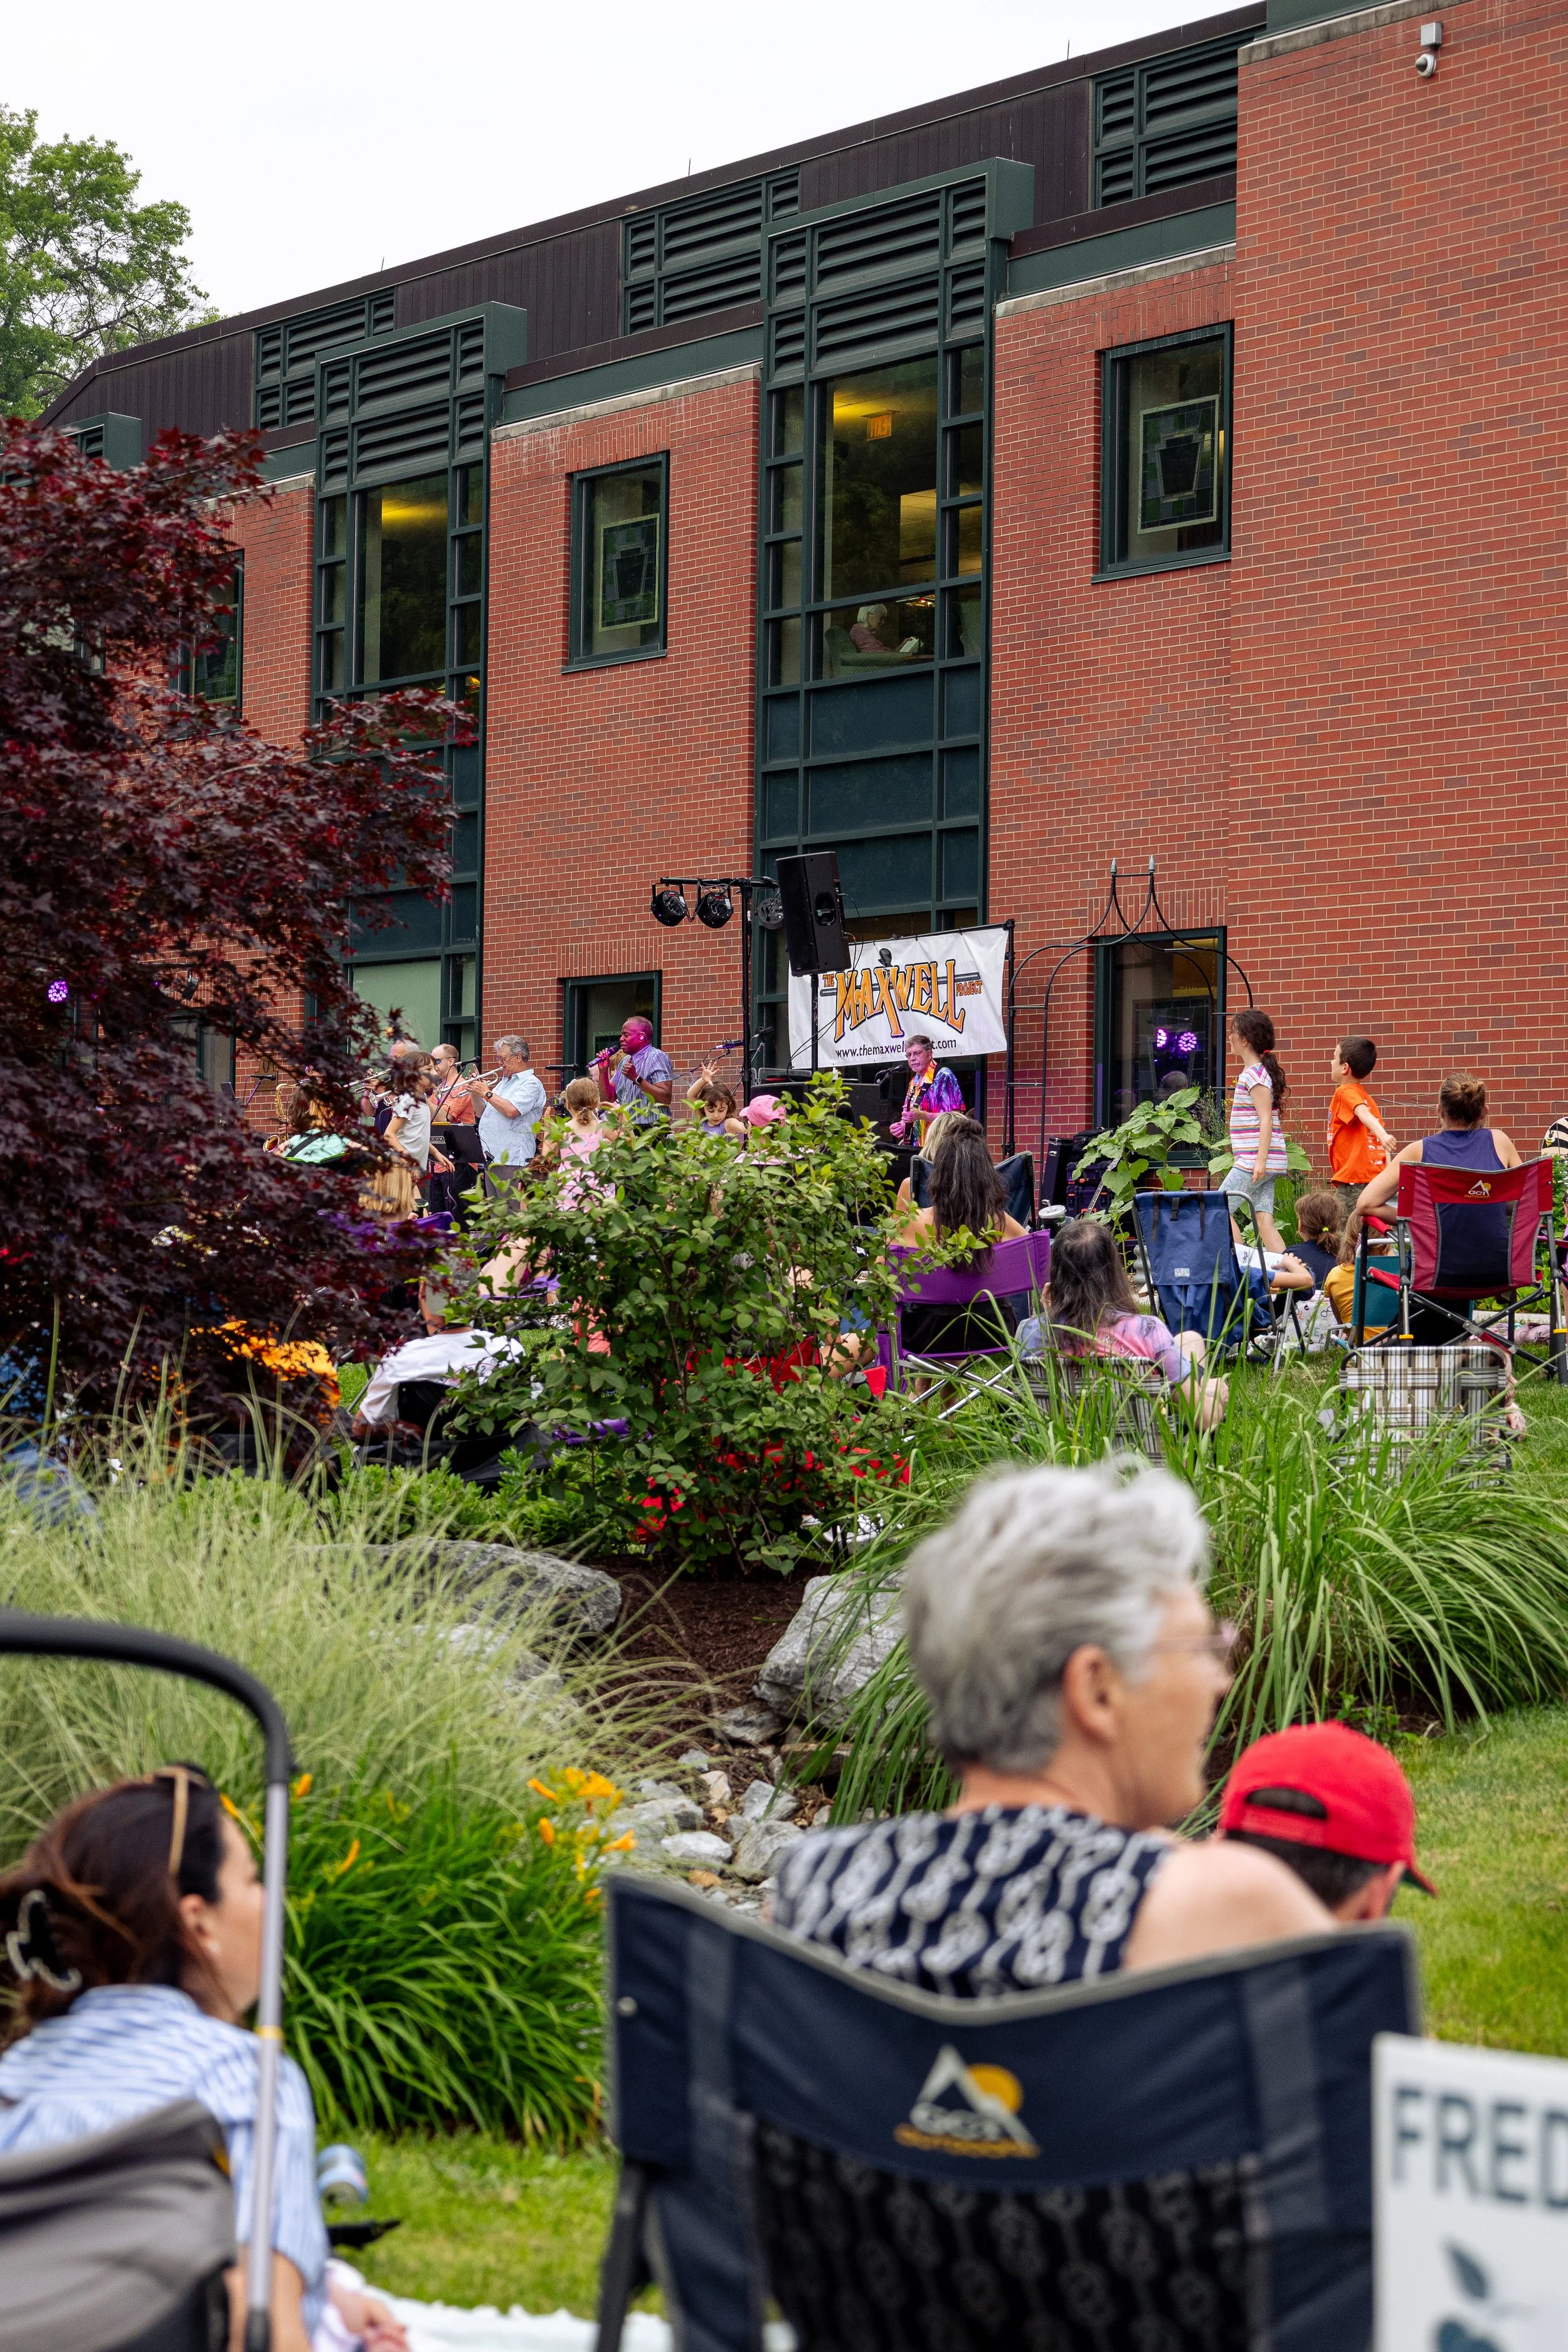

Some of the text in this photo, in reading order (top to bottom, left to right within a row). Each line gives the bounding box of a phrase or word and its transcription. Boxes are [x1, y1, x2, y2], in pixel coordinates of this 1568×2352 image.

[823, 959, 983, 1042] THE MAXWELL PROJECT
